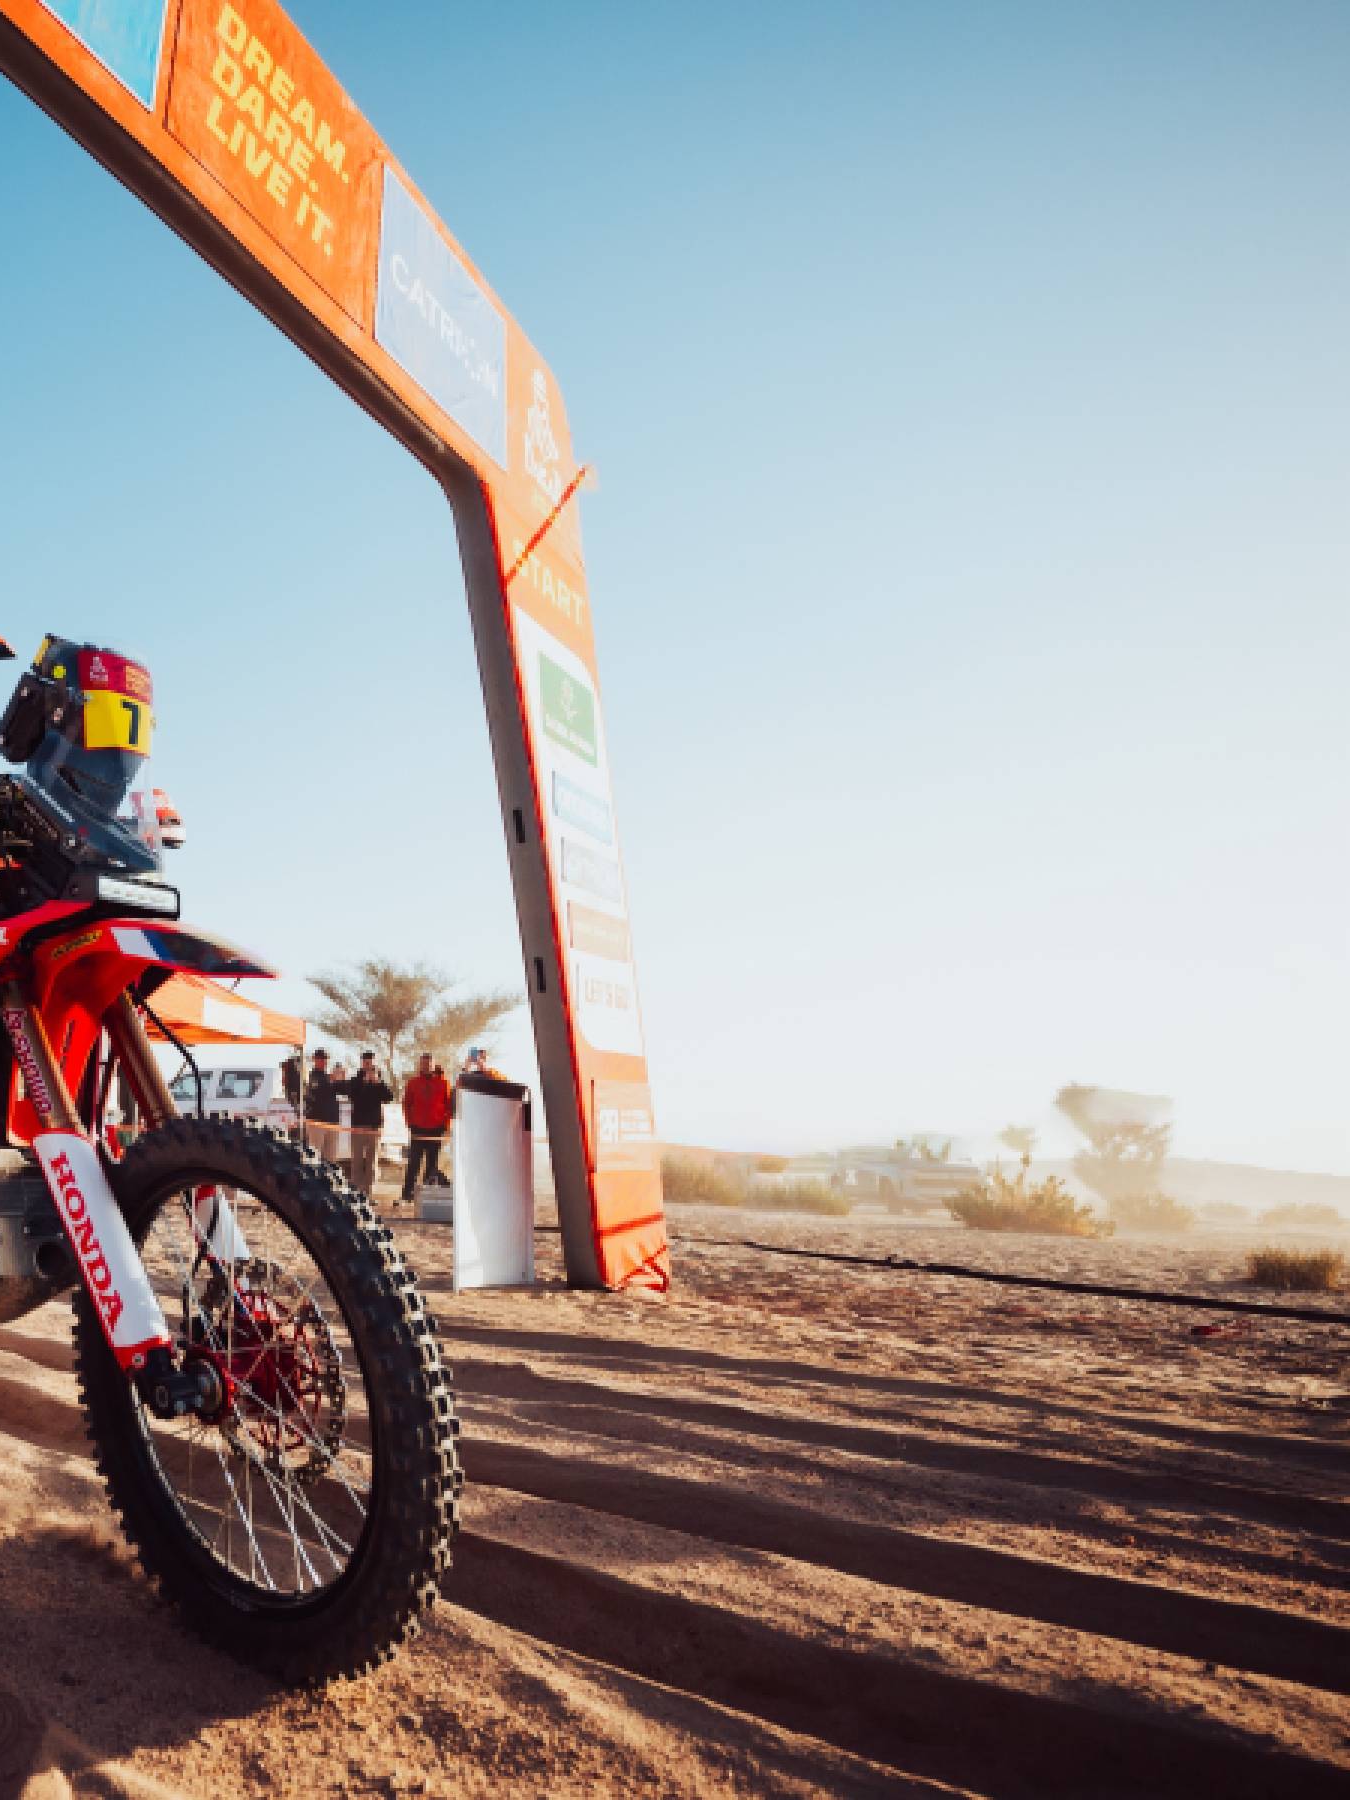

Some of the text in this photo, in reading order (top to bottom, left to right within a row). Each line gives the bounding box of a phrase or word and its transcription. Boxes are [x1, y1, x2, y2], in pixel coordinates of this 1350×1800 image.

[206, 99, 333, 256] LIVE IT.
[212, 54, 318, 192] DARE.
[217, 4, 350, 184] DREAM.
[50, 1150, 126, 1337] HONDA
